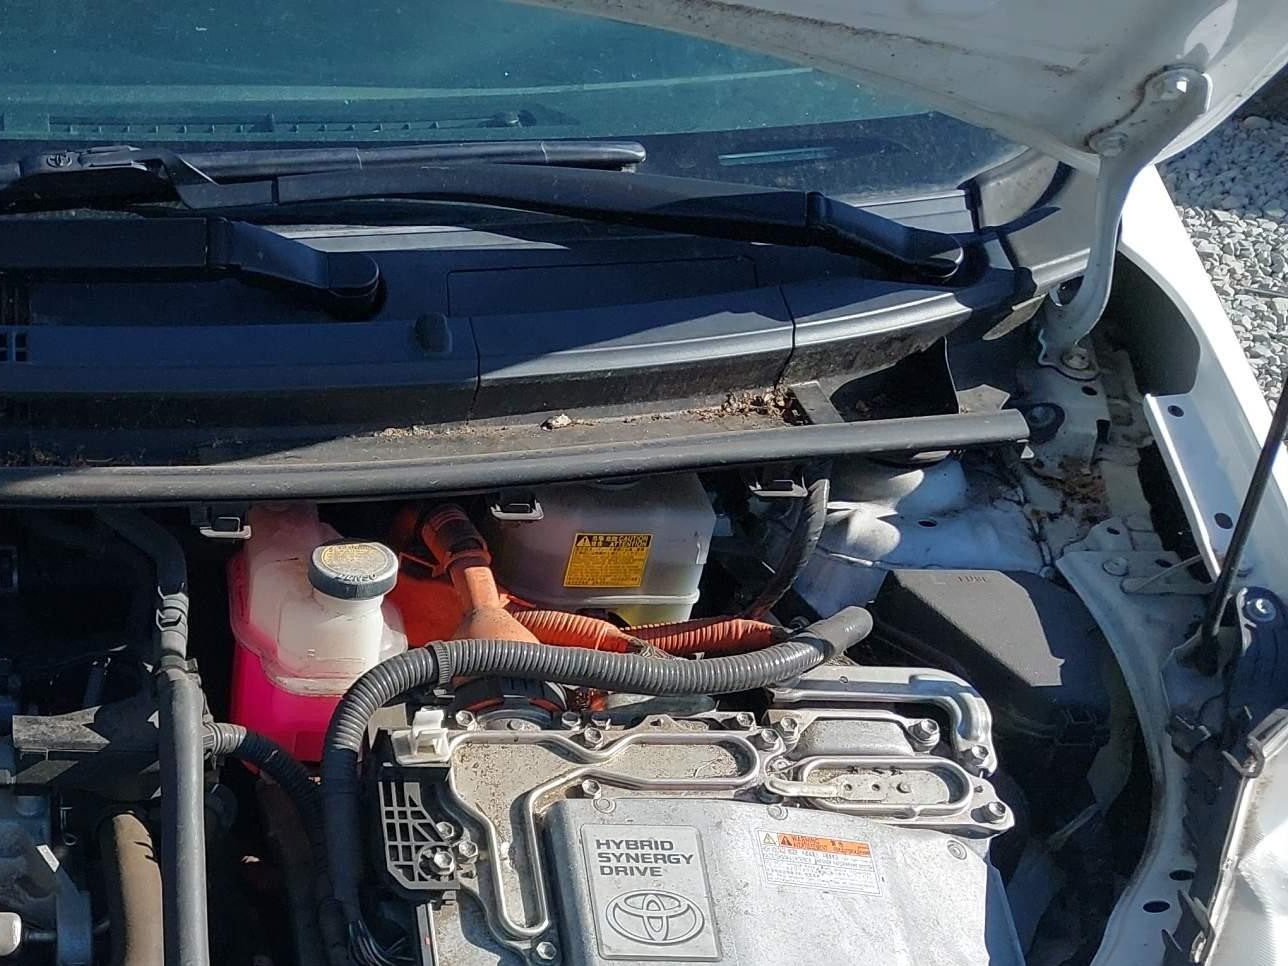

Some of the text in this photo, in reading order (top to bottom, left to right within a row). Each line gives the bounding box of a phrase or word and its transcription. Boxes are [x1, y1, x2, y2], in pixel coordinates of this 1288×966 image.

[595, 839, 674, 851] HYBRID
[597, 852, 694, 865] SYNERGY
[599, 865, 664, 877] DRIVE
